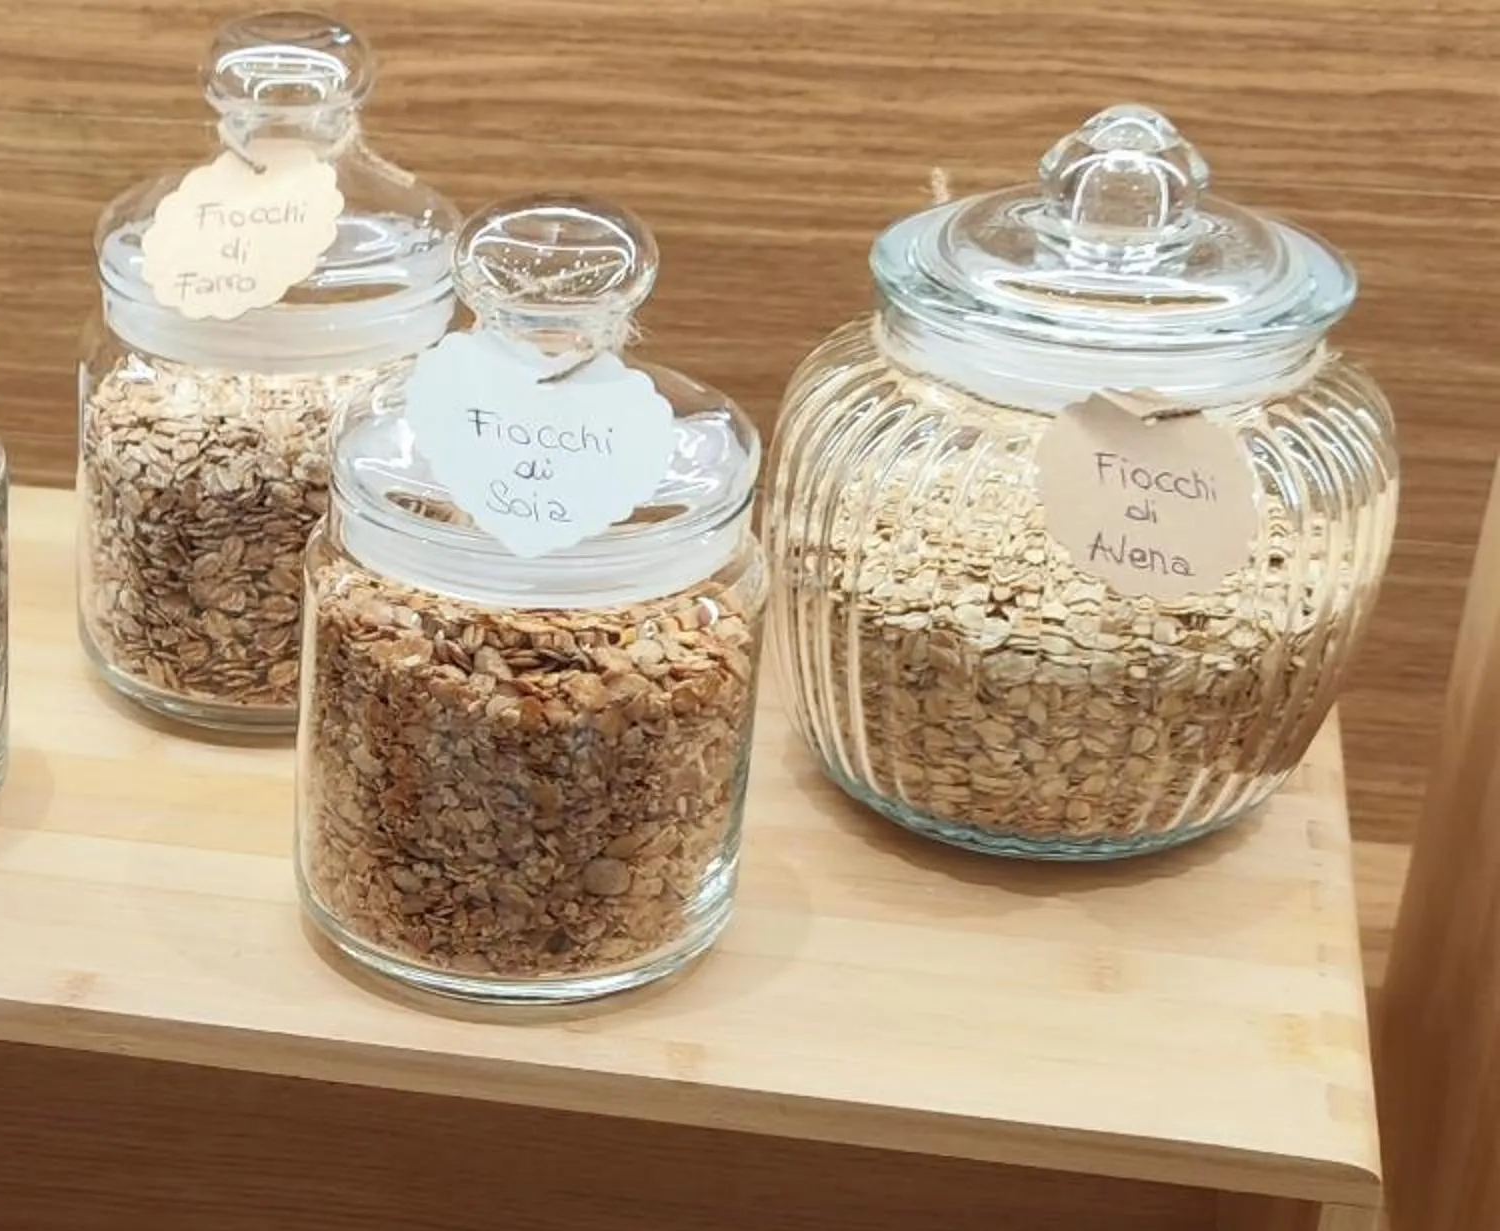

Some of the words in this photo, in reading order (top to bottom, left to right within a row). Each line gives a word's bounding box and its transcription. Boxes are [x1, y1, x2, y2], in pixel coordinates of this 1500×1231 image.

[195, 200, 308, 231] Fiocchi
[220, 236, 251, 265] di
[174, 271, 256, 300] Farro
[467, 408, 613, 455] Fiocchi
[514, 458, 554, 481] di
[1094, 452, 1217, 502] Fiocchi
[486, 479, 573, 522] Soia
[1124, 498, 1157, 524] di
[1087, 531, 1196, 577] Avena
